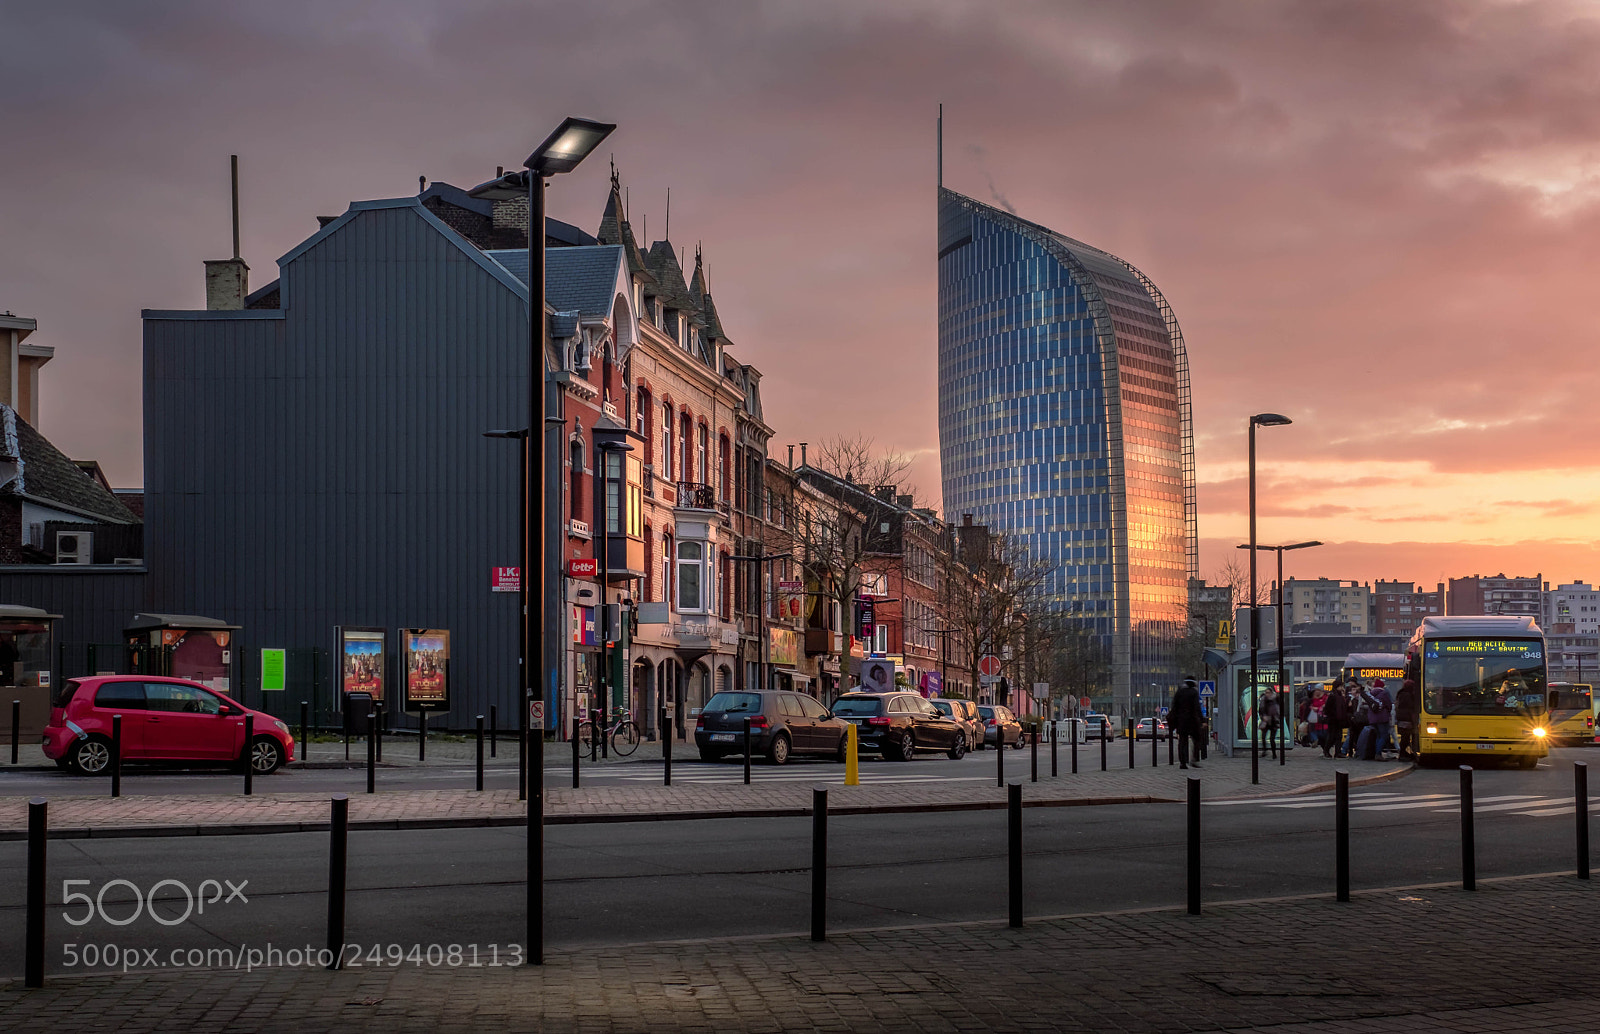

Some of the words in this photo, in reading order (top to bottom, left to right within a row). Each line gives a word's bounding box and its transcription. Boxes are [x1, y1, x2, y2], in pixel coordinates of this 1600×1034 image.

[498, 567, 519, 577] I.K.
[572, 562, 594, 572] Lotto
[1220, 621, 1229, 637] A
[1432, 641, 1440, 652] 4
[1524, 651, 1542, 659] 948
[1350, 668, 1355, 678] 1
[1360, 668, 1406, 678] CORONMEUS
